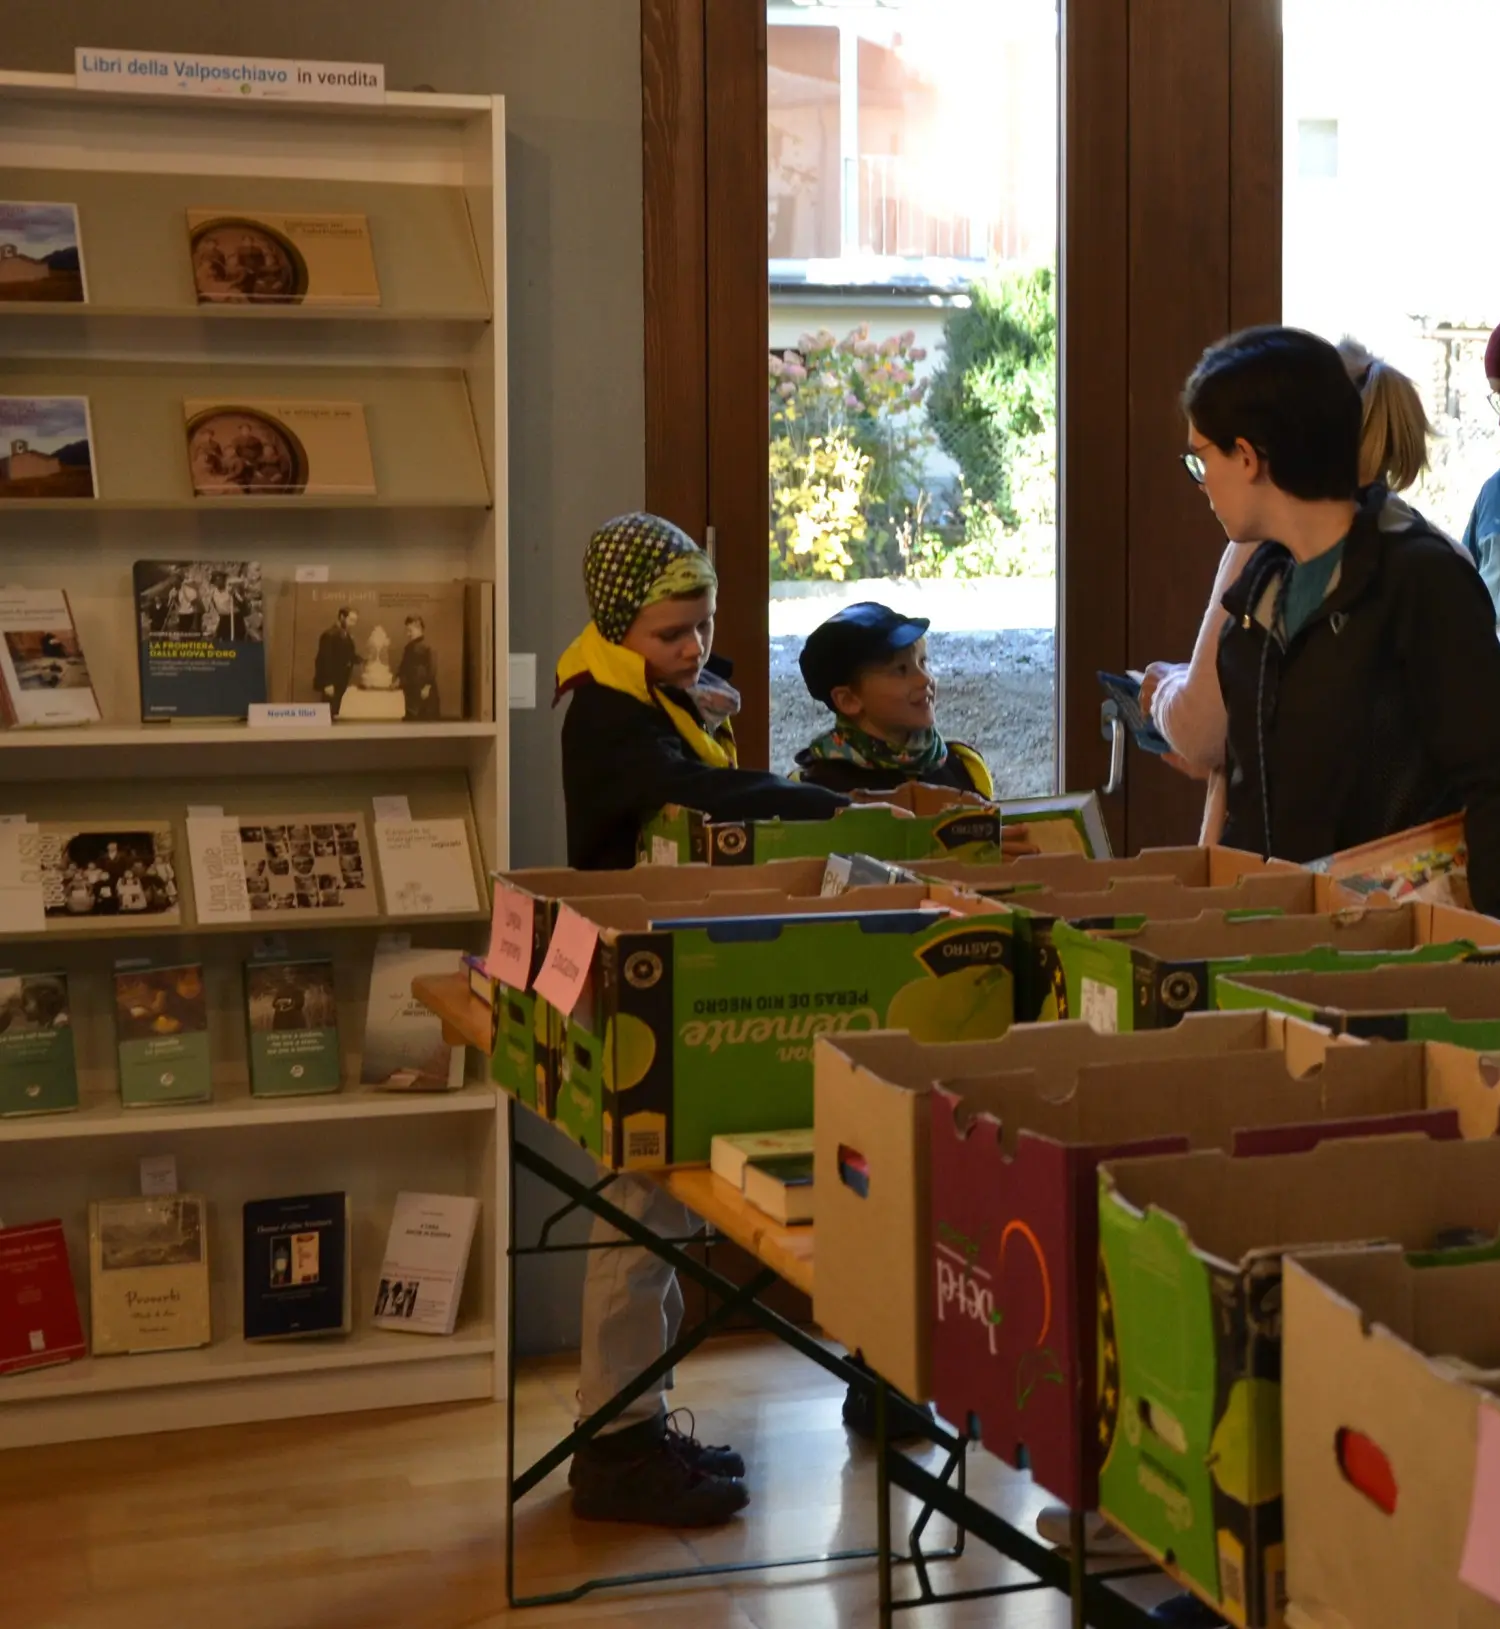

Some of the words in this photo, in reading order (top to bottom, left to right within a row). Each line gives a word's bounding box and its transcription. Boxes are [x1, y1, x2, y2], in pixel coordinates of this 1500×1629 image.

[82, 55, 122, 75] Libri
[127, 57, 169, 77] della
[174, 60, 288, 84] Valposchiavo
[297, 67, 312, 85] in
[317, 69, 379, 88] vendita
[149, 641, 161, 650] LA
[163, 640, 214, 650] FRONTIERA
[943, 940, 1004, 959] CASTRO
[693, 996, 753, 1015] NEGRO
[757, 995, 785, 1012] RIO
[788, 992, 810, 1010] DE
[815, 988, 870, 1006] PERAS
[125, 1287, 181, 1309] Proverbi
